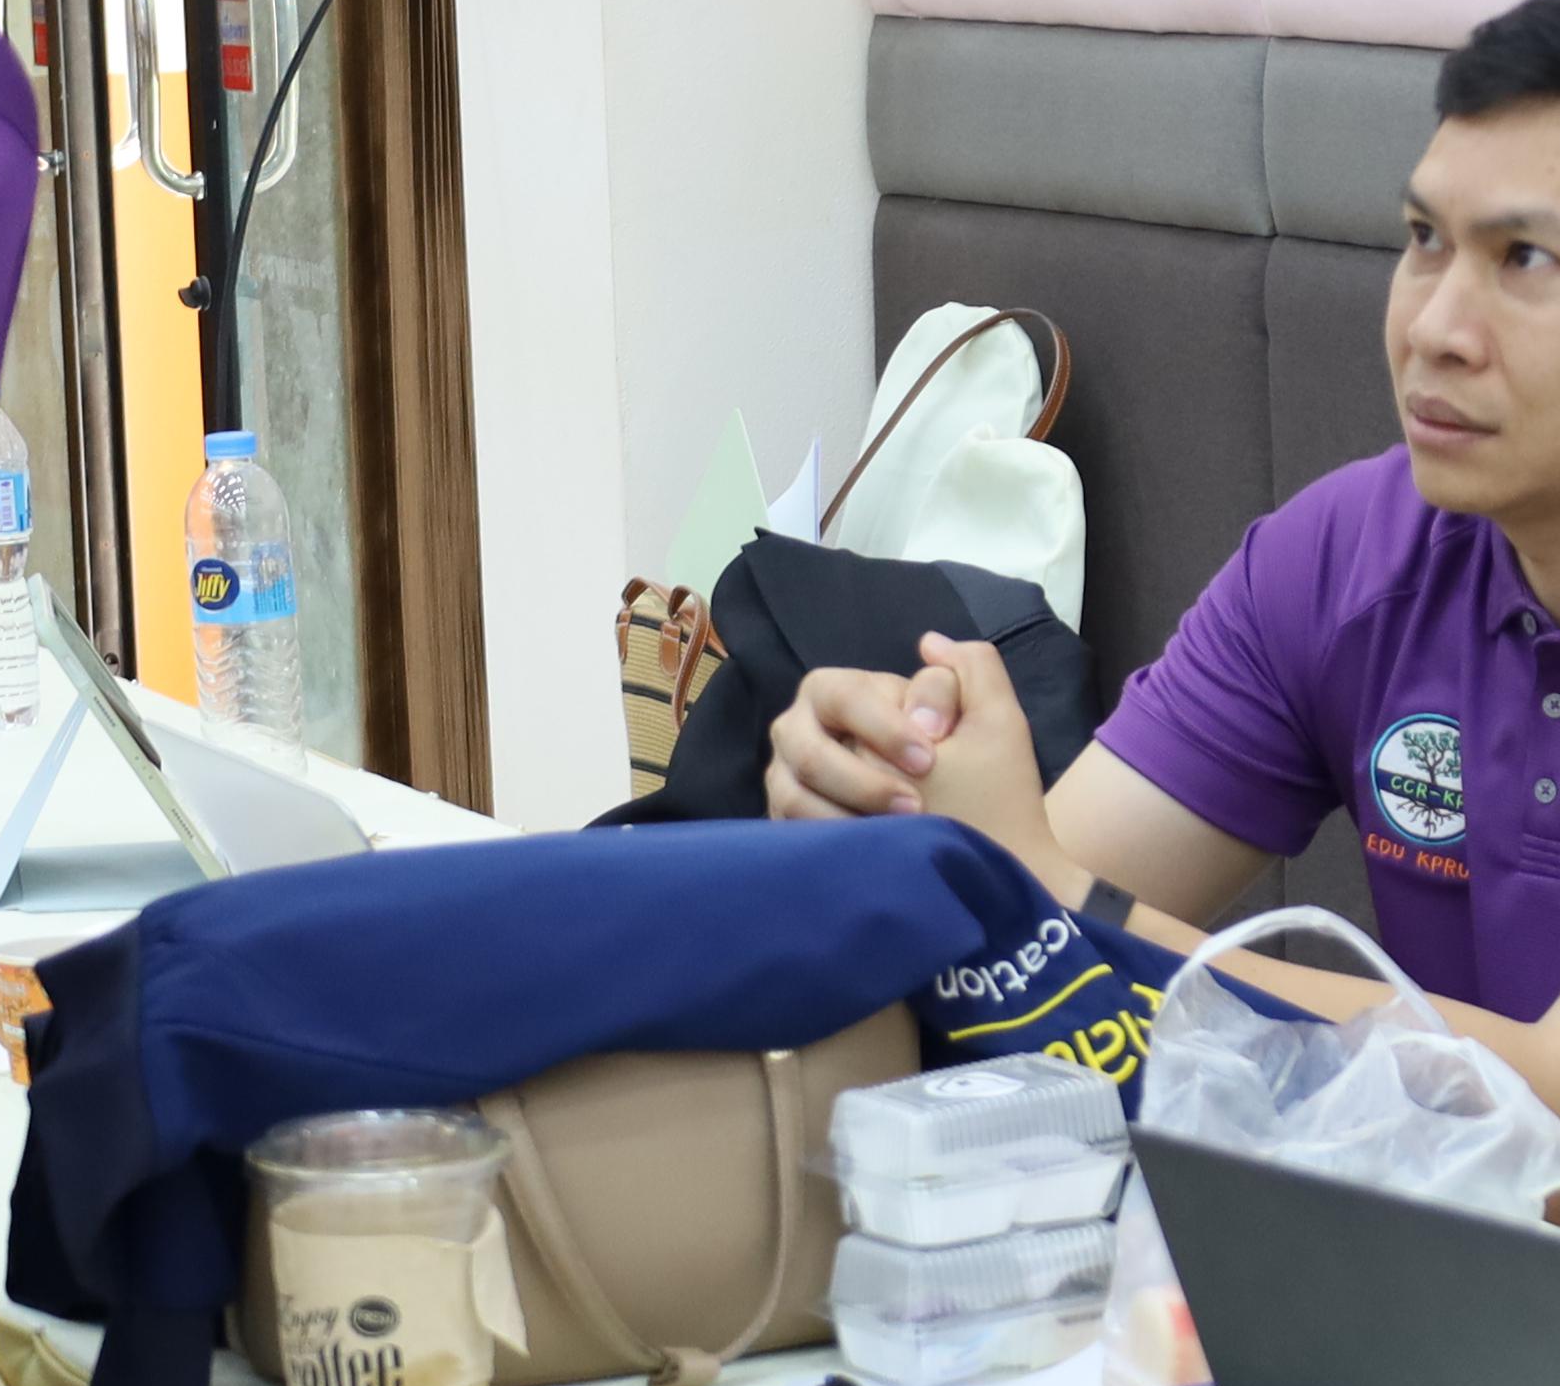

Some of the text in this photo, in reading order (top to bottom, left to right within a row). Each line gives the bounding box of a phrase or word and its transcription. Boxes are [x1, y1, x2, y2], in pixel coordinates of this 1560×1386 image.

[196, 572, 232, 605] Jiffy
[1366, 832, 1471, 879] EDU KPRU
